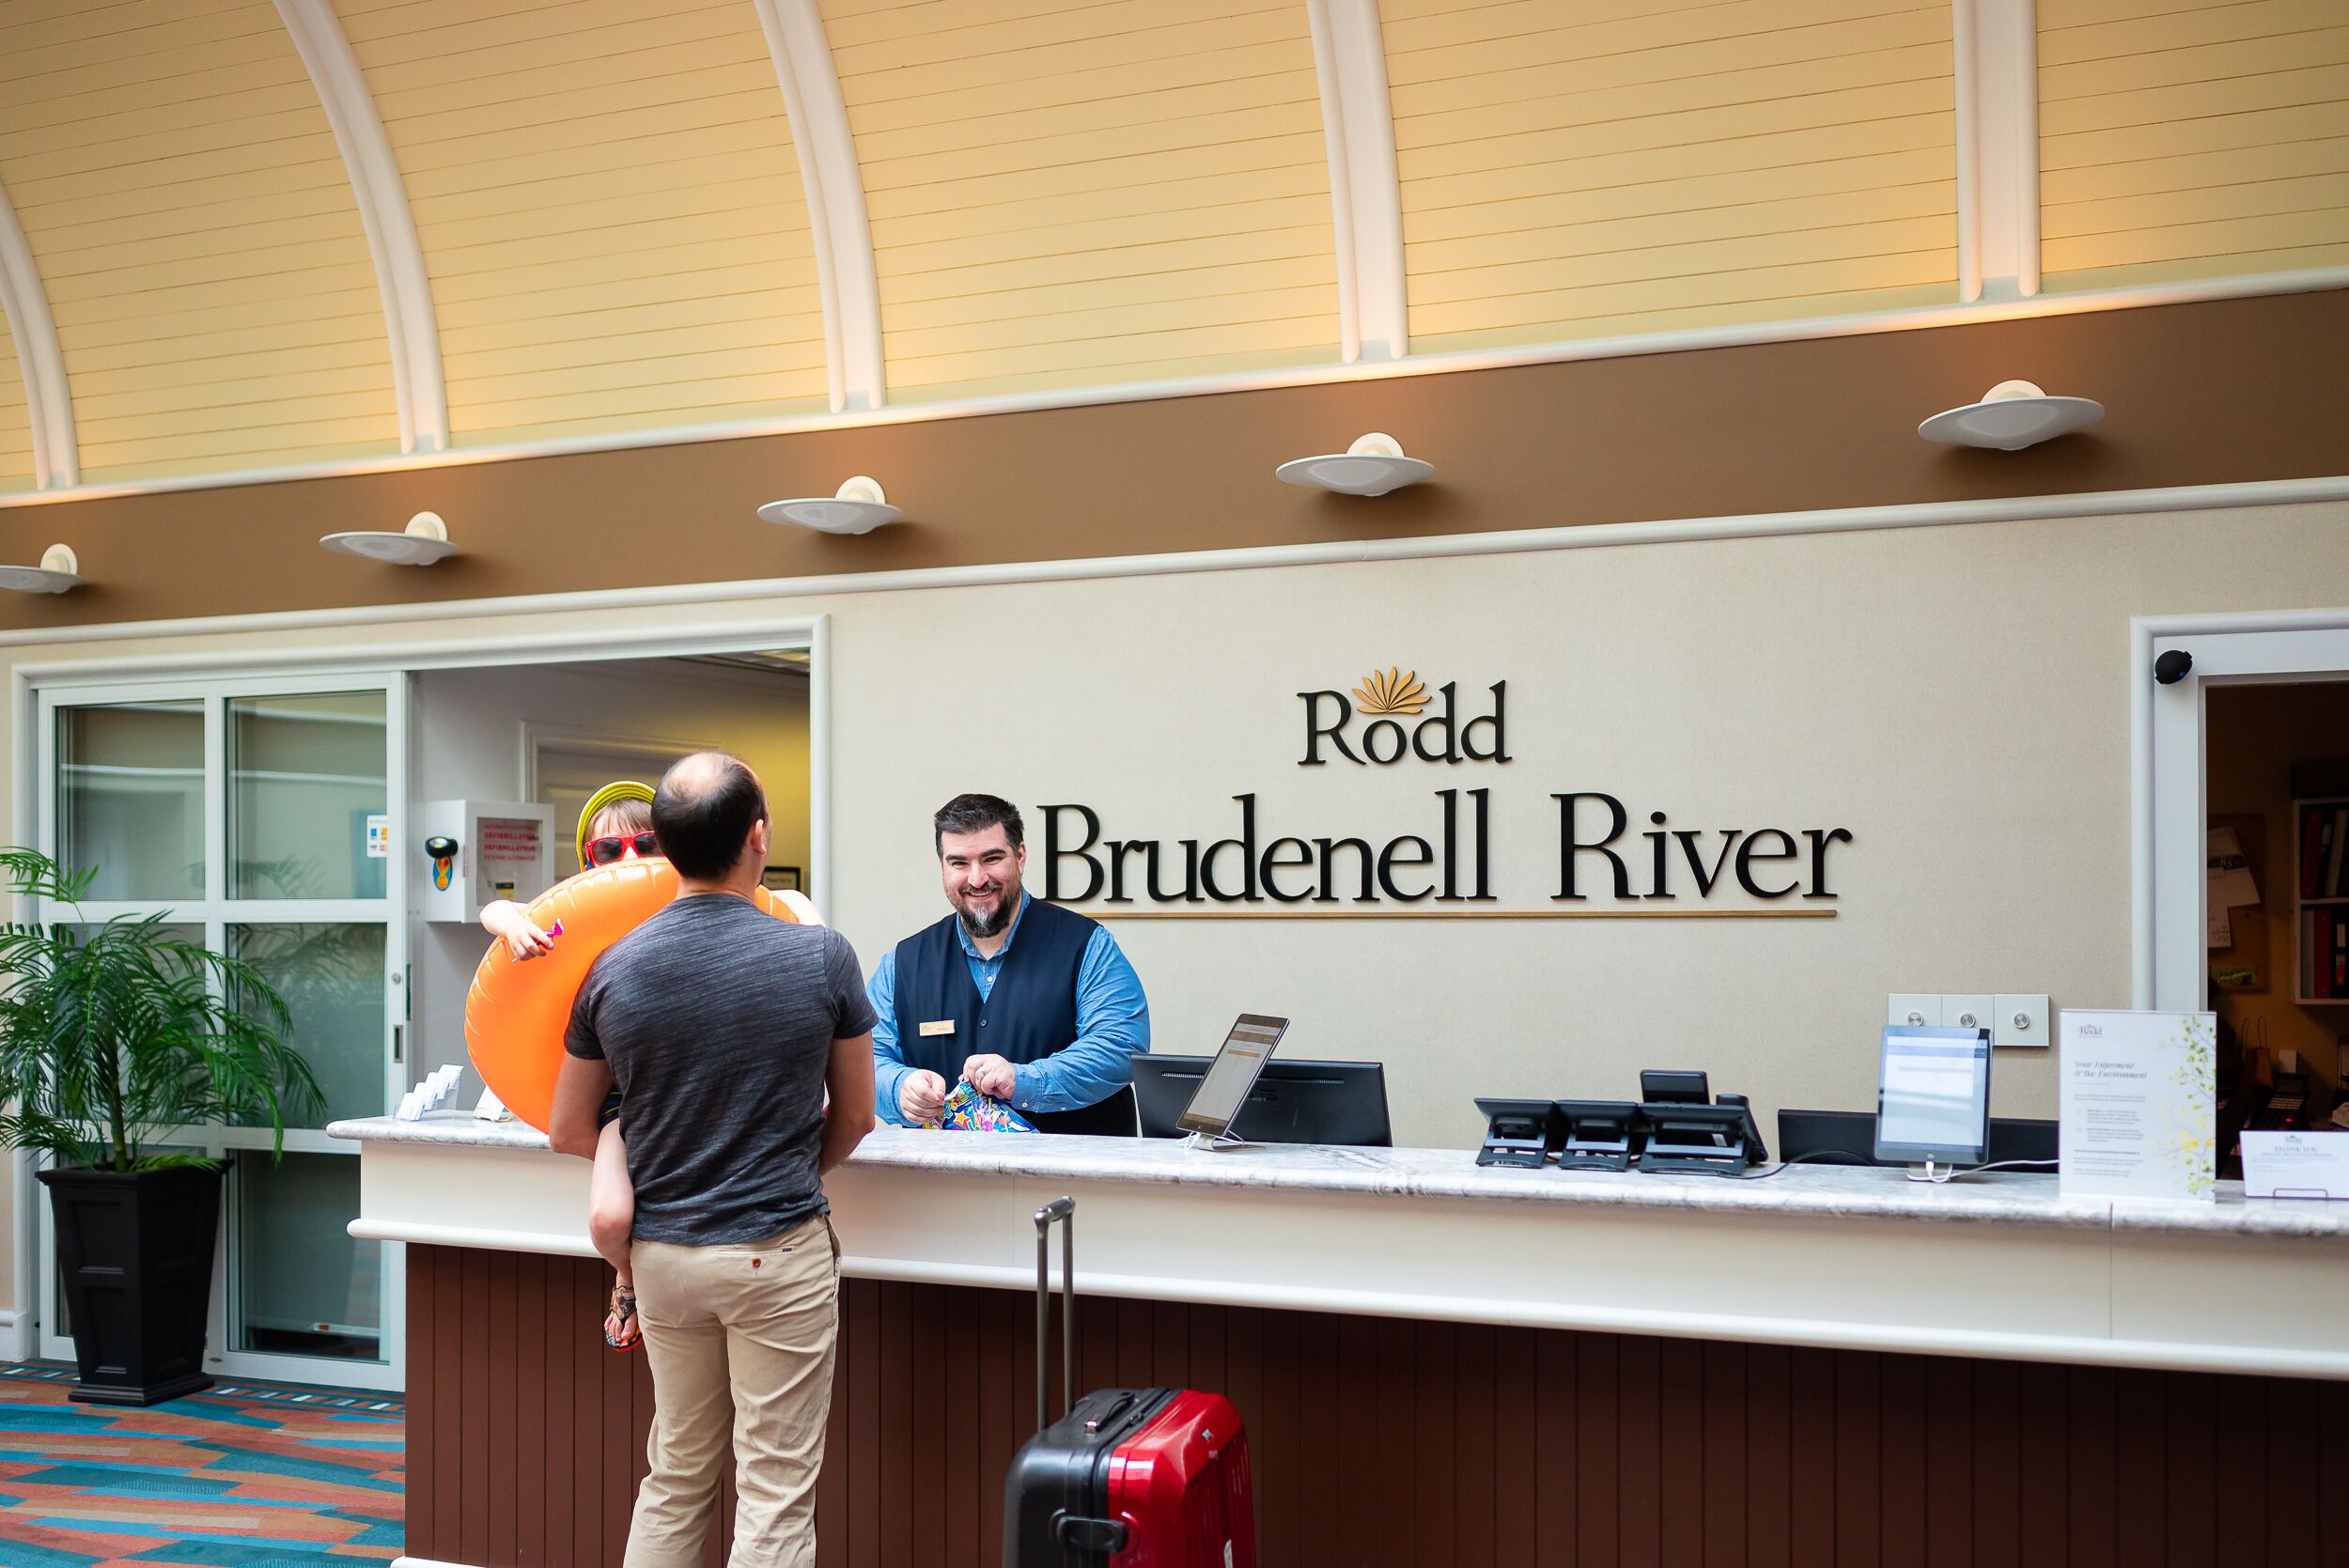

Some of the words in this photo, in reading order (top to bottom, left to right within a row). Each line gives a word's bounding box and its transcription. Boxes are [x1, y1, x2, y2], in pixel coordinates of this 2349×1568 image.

[1296, 679, 1513, 766] Rodd
[1035, 788, 1497, 903] Brudenell
[1550, 792, 1854, 902] River
[2098, 1070, 2148, 1079] Environment
